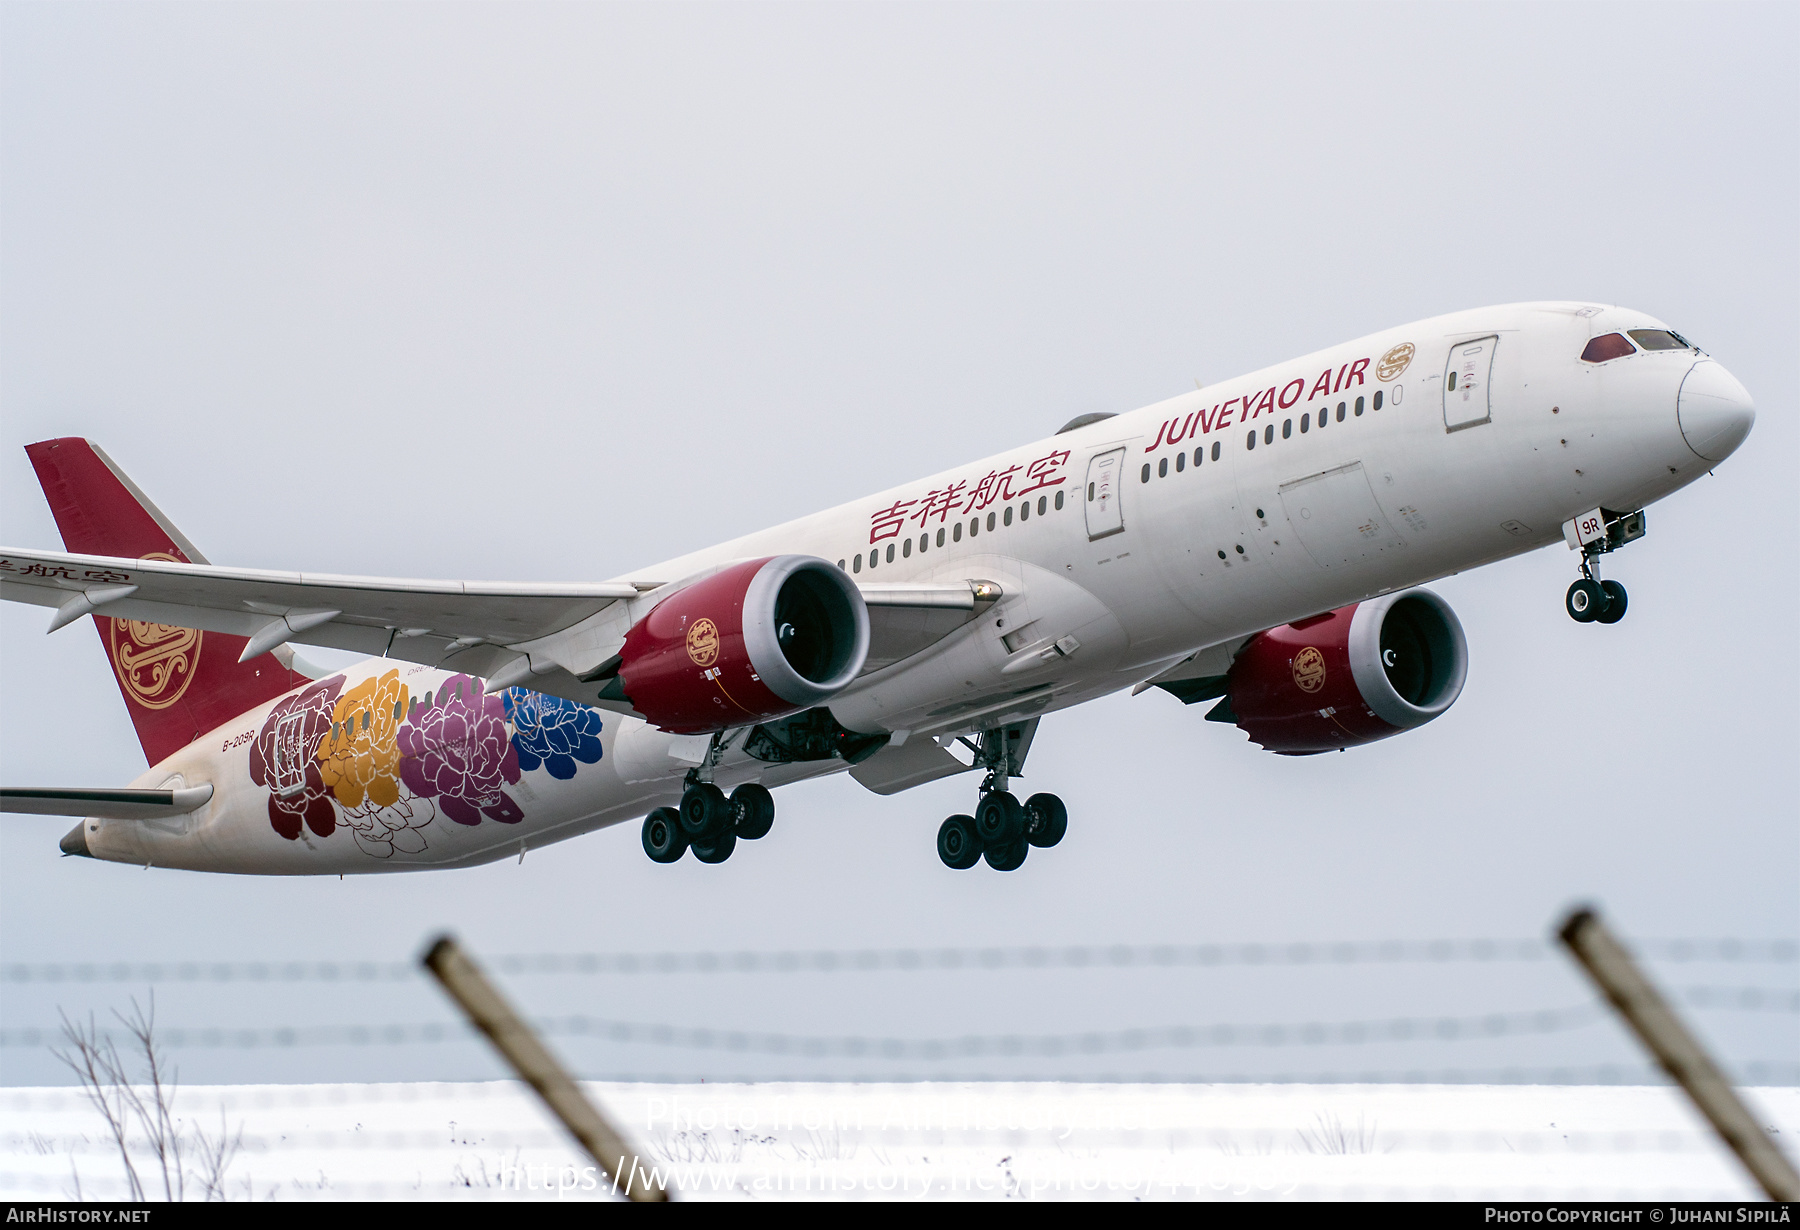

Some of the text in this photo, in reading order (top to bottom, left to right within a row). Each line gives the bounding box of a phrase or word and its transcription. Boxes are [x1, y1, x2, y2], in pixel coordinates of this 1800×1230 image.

[1144, 357, 1371, 453] JUNEYAO AIR
[869, 449, 1071, 545] 吉祥航空
[1582, 517, 1600, 535] 9R
[222, 729, 255, 753] B-209R
